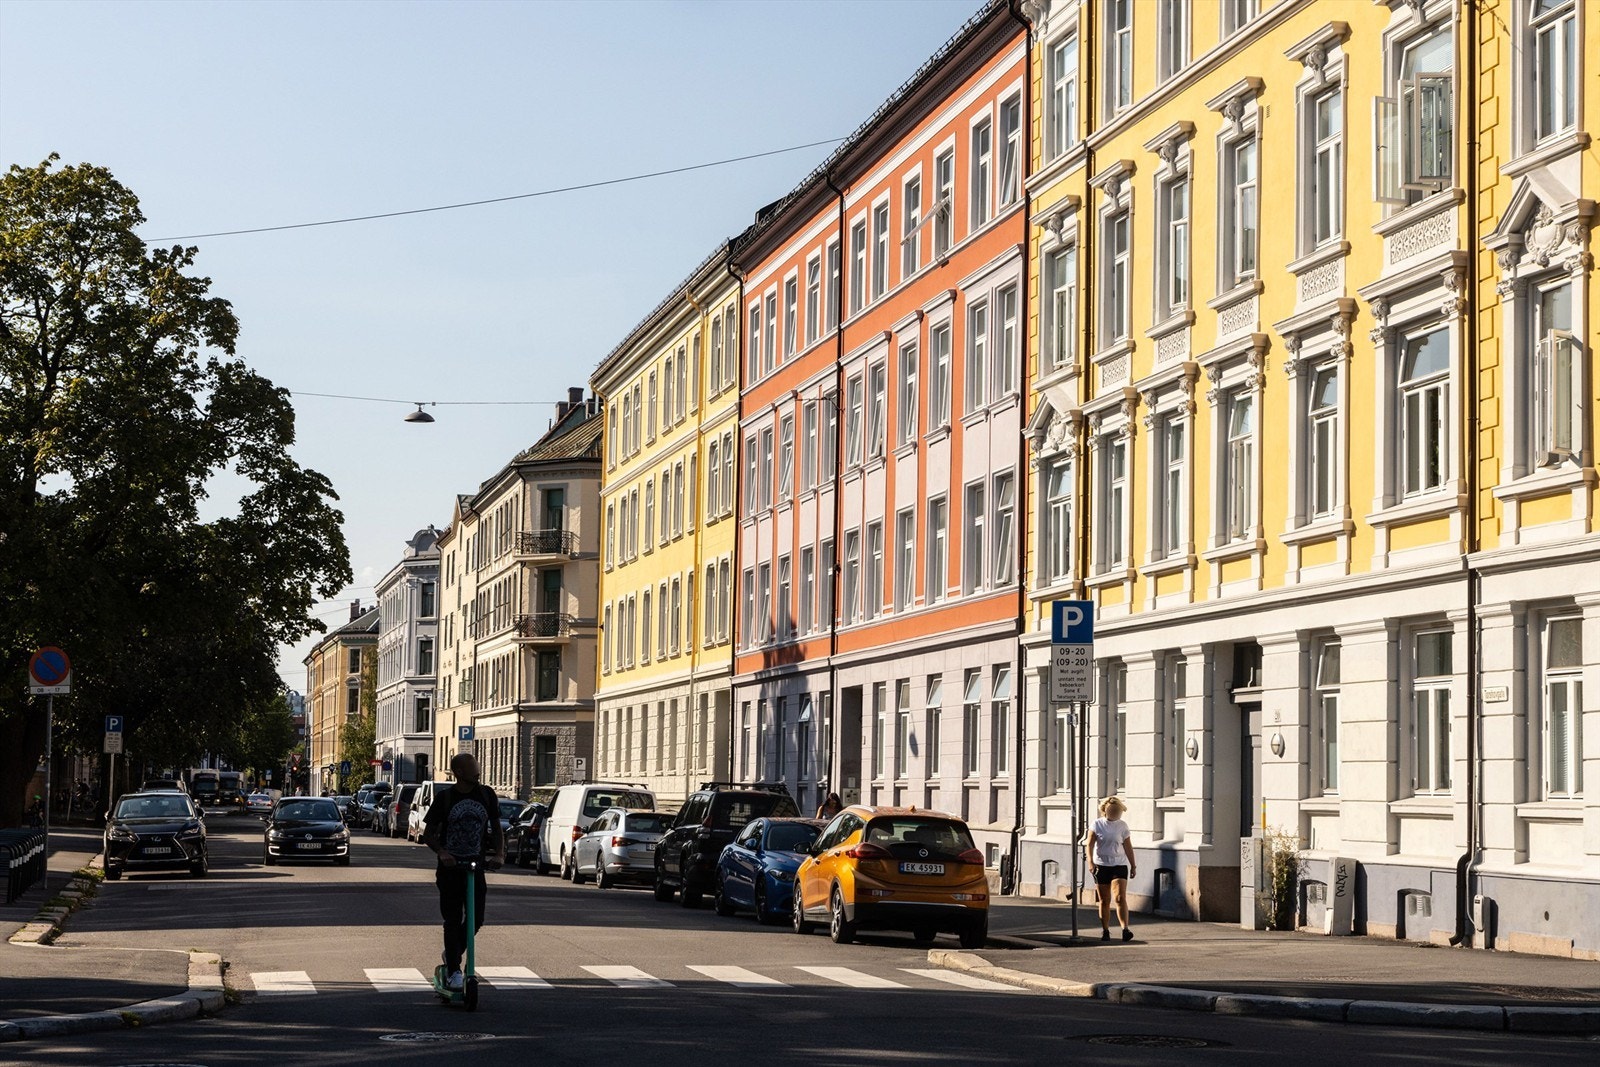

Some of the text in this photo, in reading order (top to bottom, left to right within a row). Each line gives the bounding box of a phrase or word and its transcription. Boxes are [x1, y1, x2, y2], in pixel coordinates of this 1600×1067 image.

[1062, 606, 1084, 638] P
[110, 717, 119, 730] P
[461, 727, 470, 739] P
[576, 758, 584, 769] P
[905, 863, 943, 873] EK 45931
